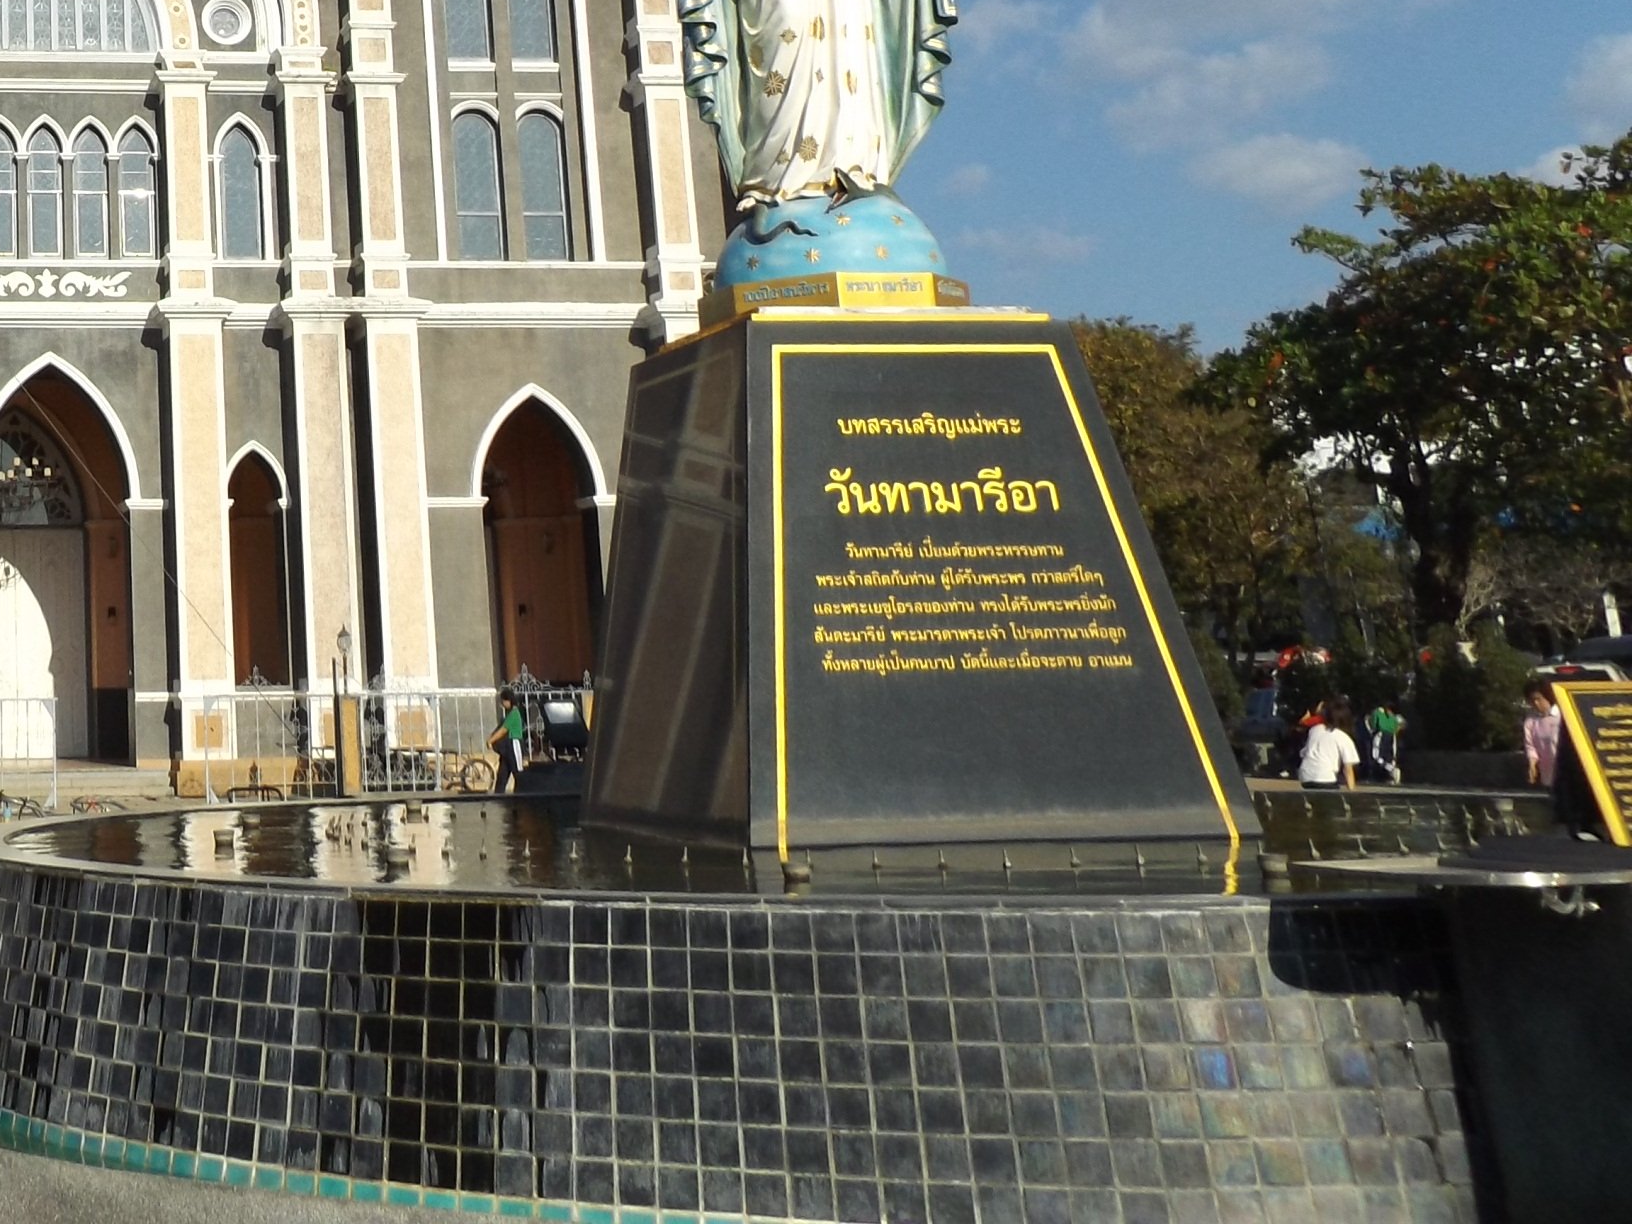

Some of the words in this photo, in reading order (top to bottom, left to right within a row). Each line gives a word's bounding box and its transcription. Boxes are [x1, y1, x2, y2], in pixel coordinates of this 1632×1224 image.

[837, 412, 1021, 441] บทสรรเสริญแม่พระ
[825, 466, 1059, 516] วันทามารีอา
